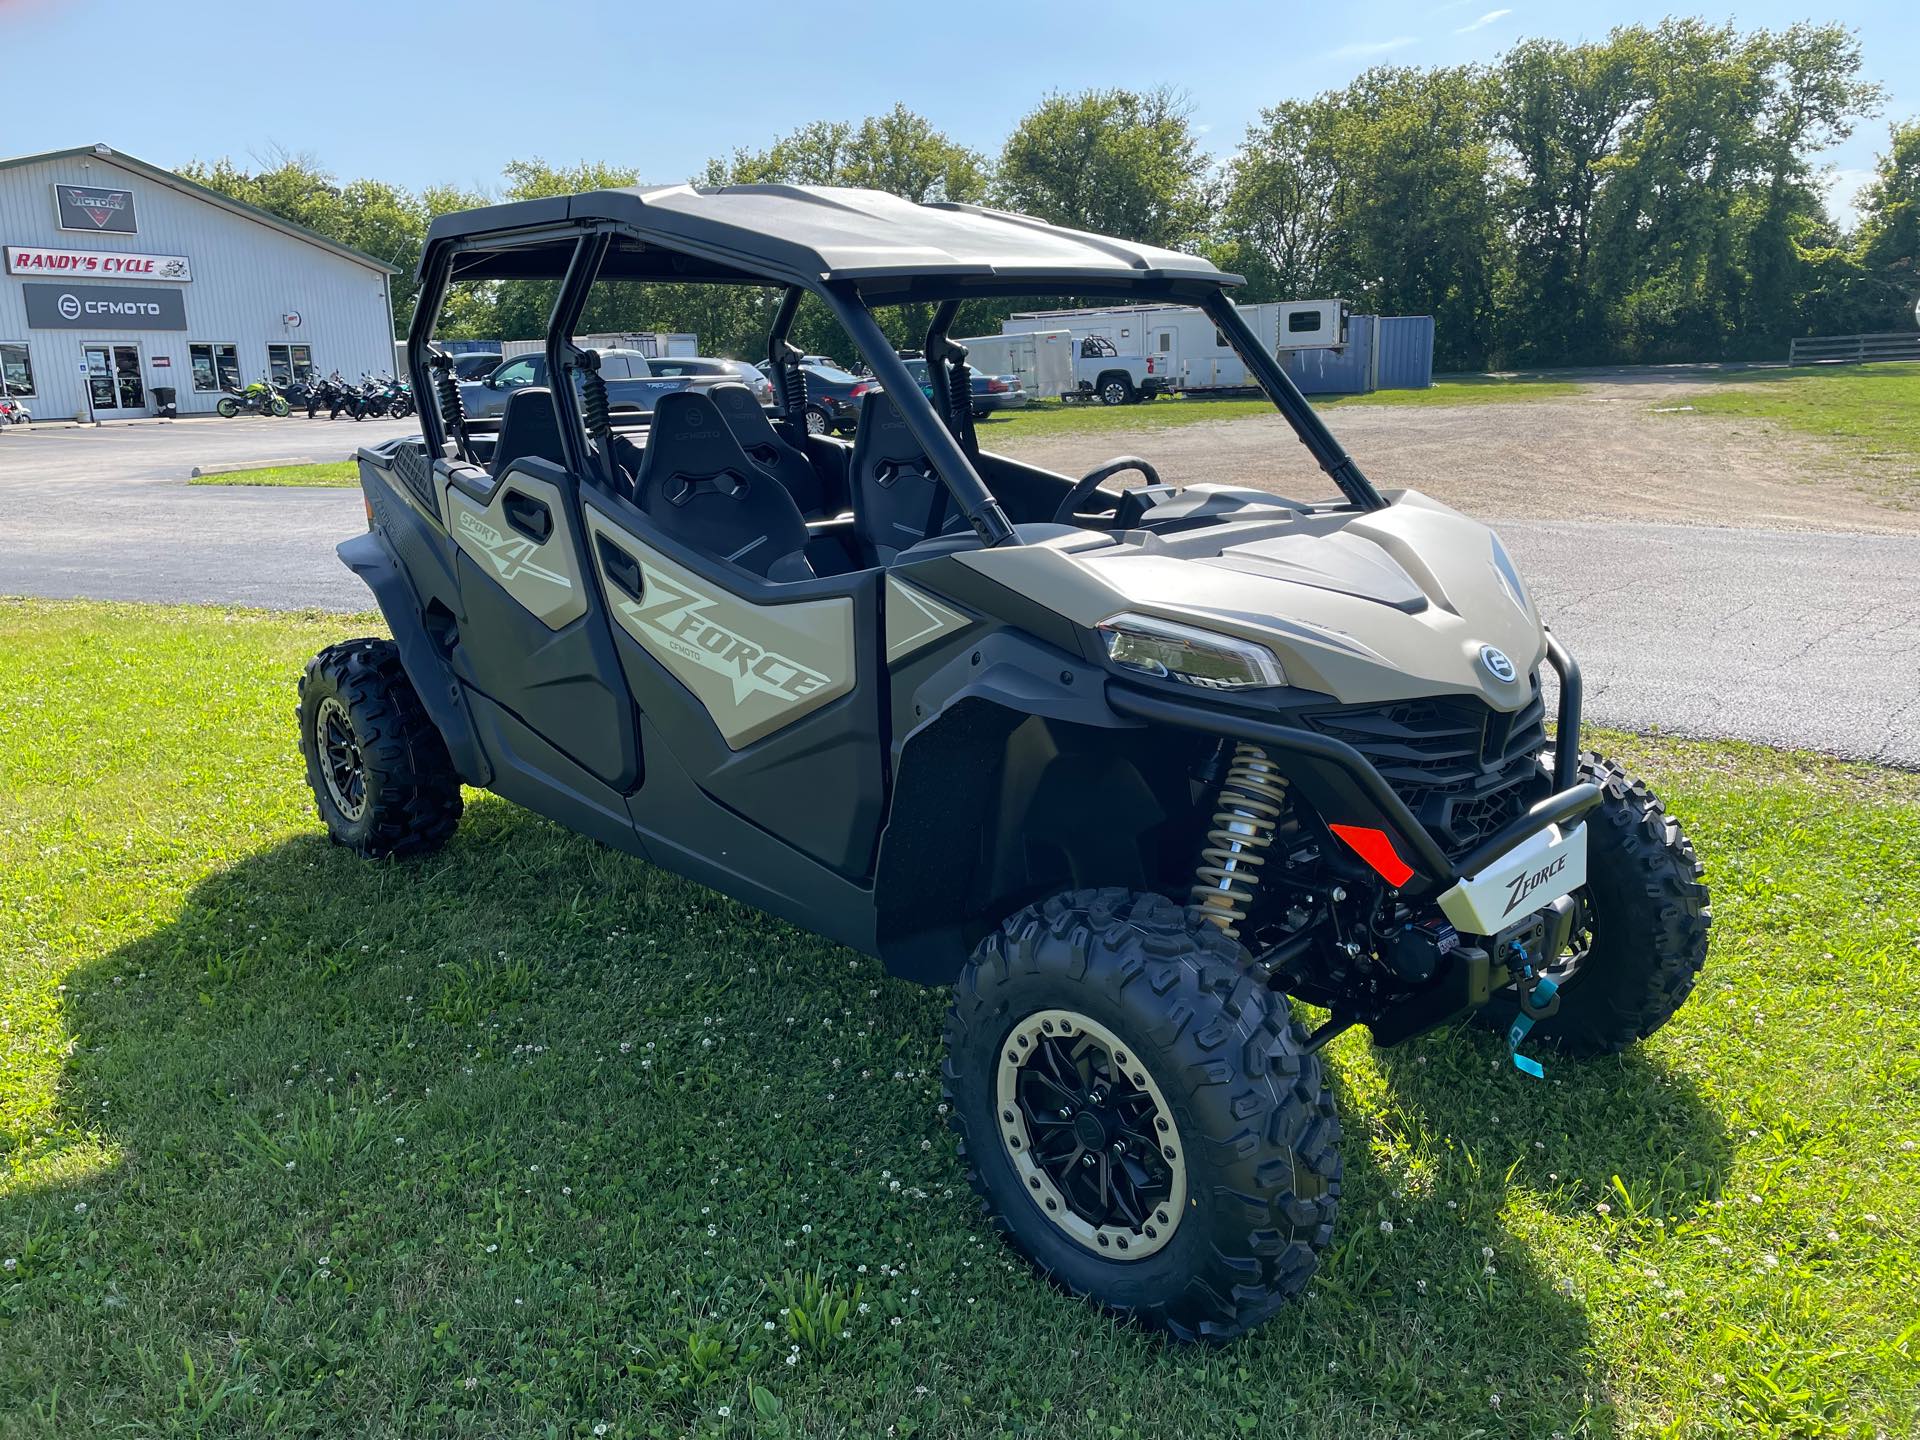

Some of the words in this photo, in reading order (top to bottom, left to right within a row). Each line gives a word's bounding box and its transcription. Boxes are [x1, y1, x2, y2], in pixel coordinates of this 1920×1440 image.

[69, 197, 126, 210] VICTORY
[15, 253, 98, 271] RANDY'S
[103, 257, 156, 274] CYCLE
[85, 302, 160, 315] CFMOTO
[462, 513, 500, 541] SPORT
[669, 640, 701, 662] CFMOTO
[1501, 853, 1568, 918] ZFORCE
